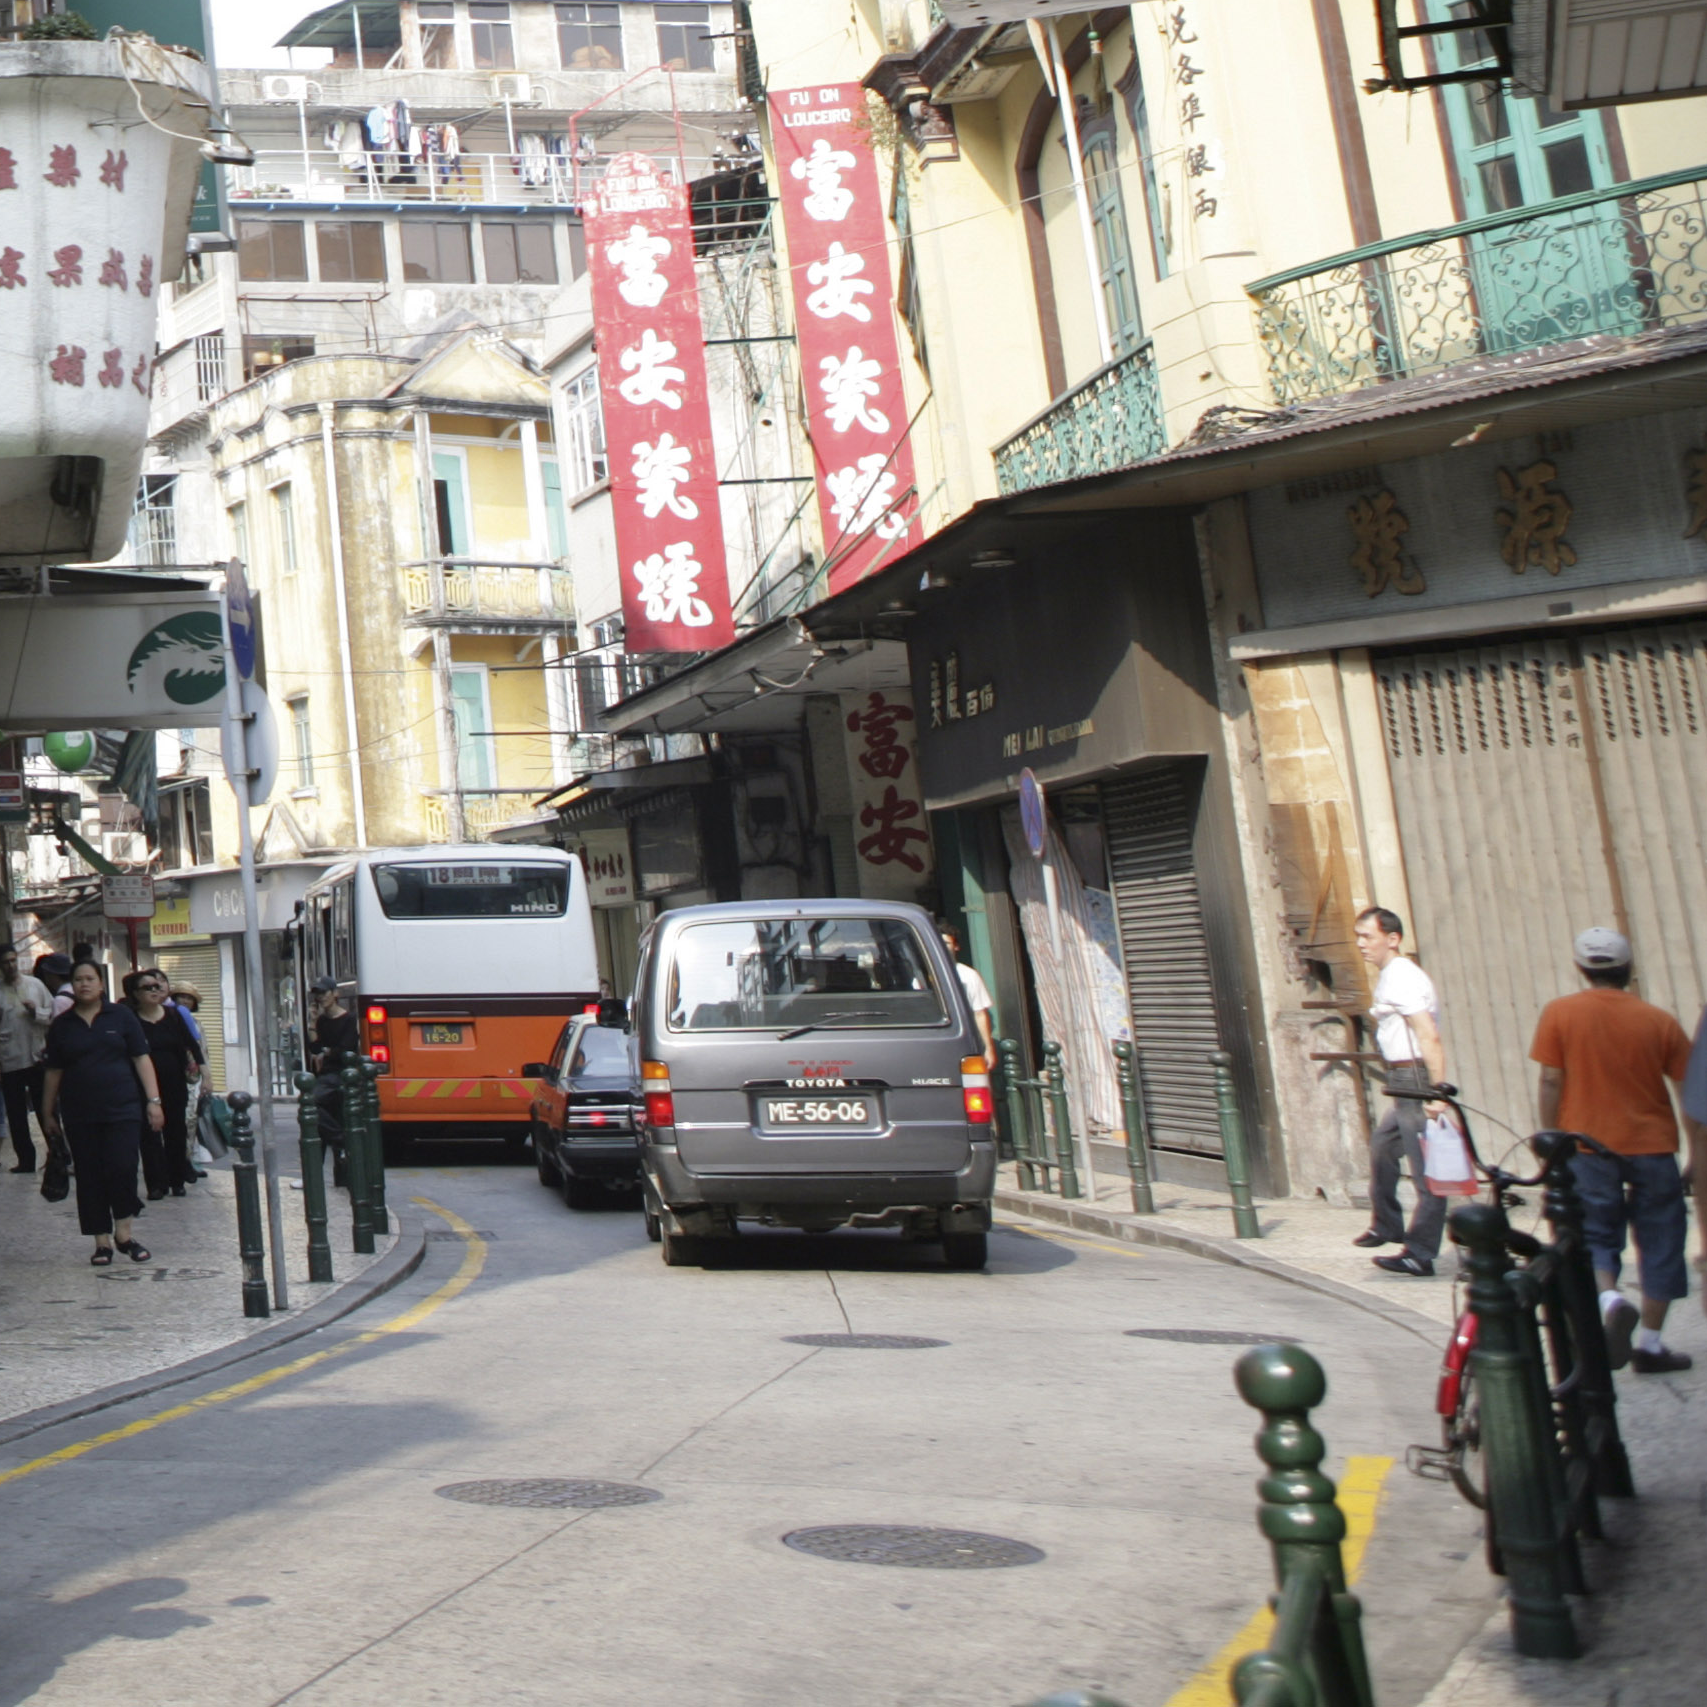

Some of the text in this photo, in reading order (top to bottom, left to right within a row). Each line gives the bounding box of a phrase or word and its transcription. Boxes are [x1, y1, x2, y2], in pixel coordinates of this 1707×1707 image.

[789, 88, 840, 106] FU ON
[783, 108, 852, 128] LOUCEIRO
[1346, 440, 1707, 598] 源號
[846, 691, 930, 874] 富安
[510, 903, 558, 913] HINO
[786, 1078, 846, 1089] TOYOTA
[911, 1077, 951, 1086] HIACE
[767, 1101, 867, 1122] ME-56-06
